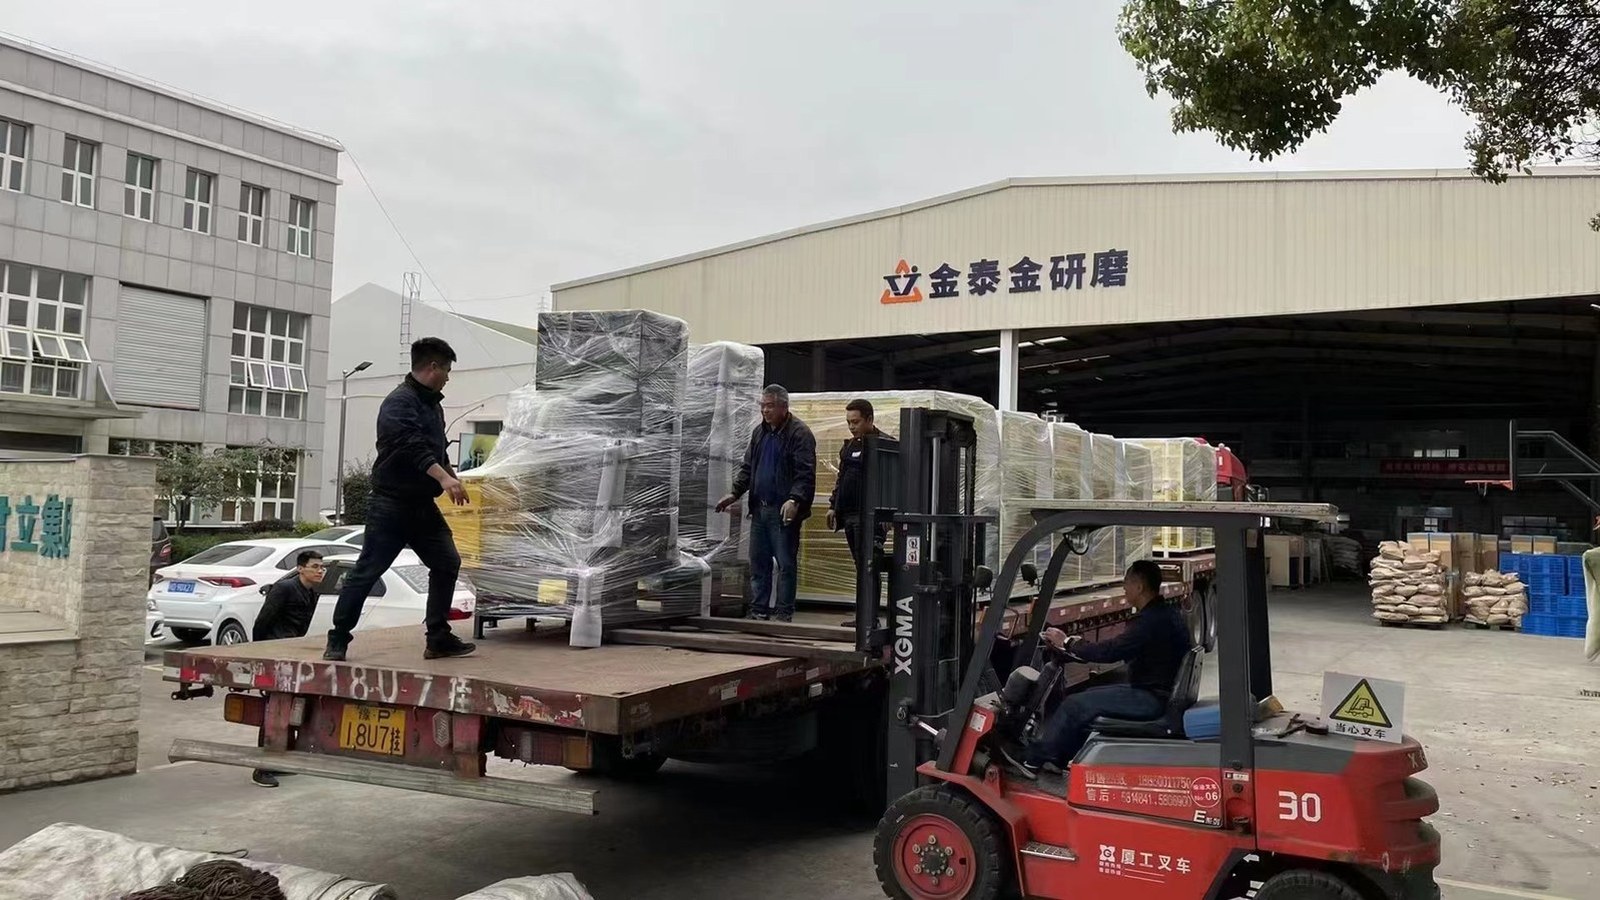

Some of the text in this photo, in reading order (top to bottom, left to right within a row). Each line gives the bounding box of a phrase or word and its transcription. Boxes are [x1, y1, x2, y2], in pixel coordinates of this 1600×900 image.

[928, 249, 1129, 299] 金泰金研磨
[894, 596, 914, 676] XGMA
[1335, 722, 1387, 739] 当心叉车
[1279, 790, 1321, 822] 30
[1121, 848, 1191, 874] 厦工叉车
